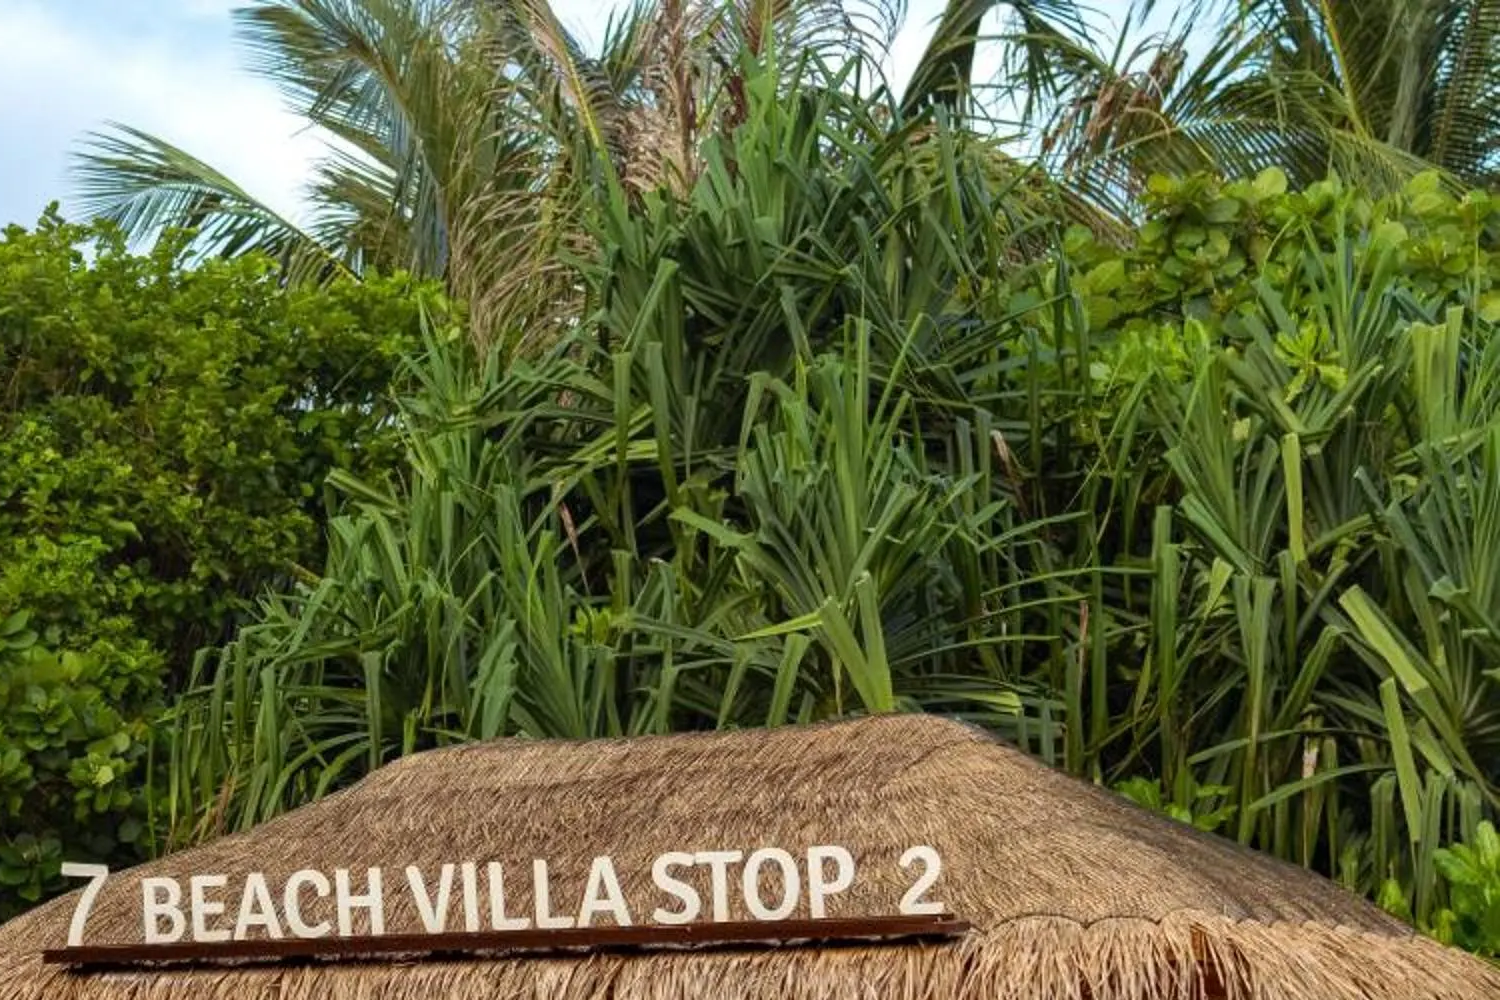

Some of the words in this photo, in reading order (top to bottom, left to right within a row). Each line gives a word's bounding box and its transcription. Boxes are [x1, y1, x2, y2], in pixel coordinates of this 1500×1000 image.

[61, 862, 109, 946] 7
[142, 866, 385, 944] BEACH
[406, 855, 633, 934] VILLA
[651, 845, 856, 924] STOP
[898, 845, 946, 915] 2
